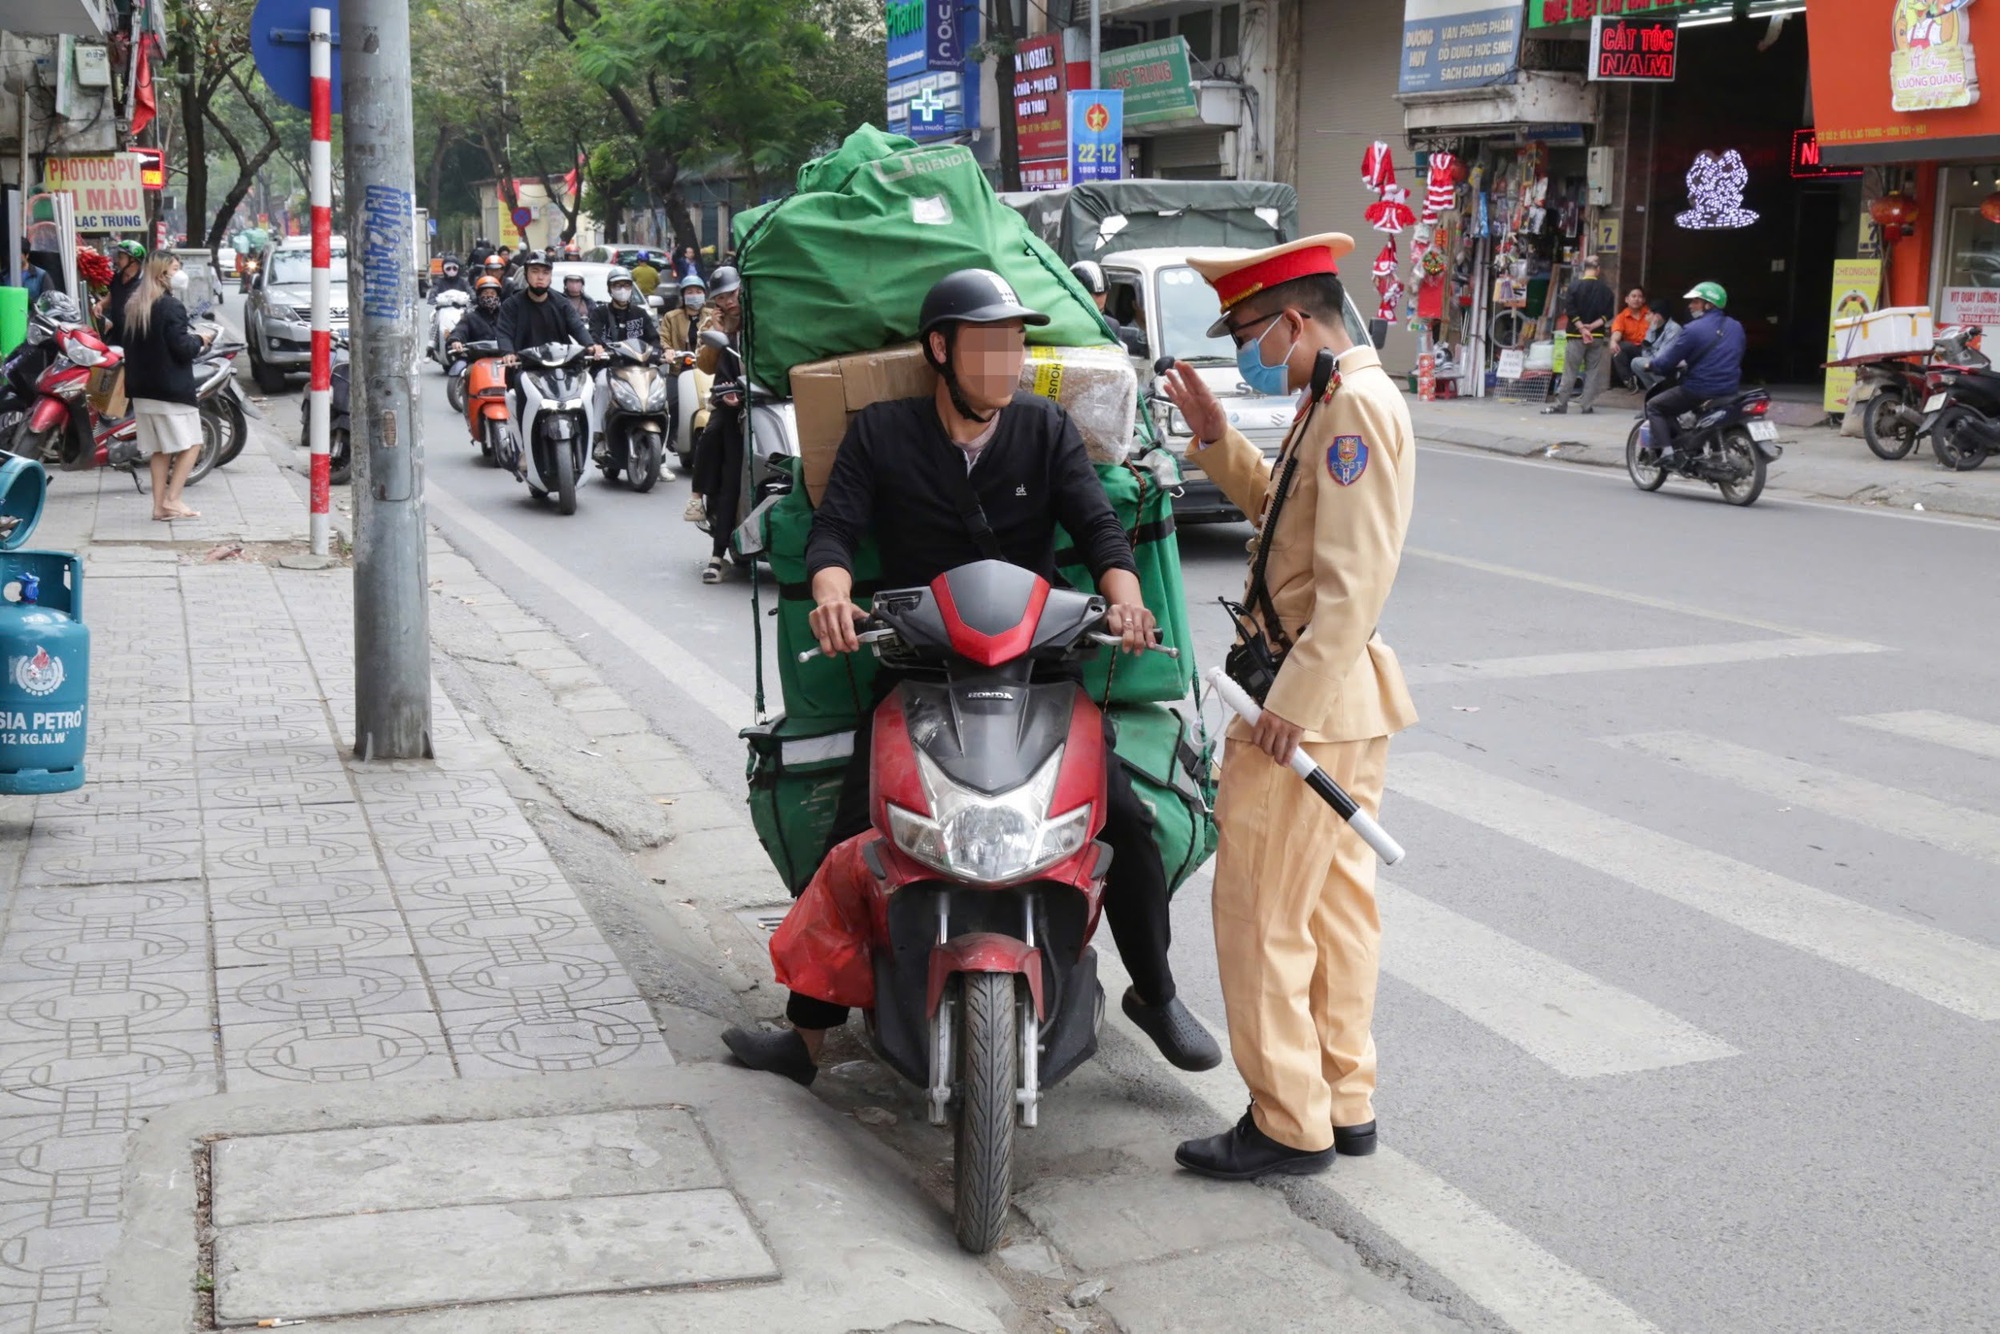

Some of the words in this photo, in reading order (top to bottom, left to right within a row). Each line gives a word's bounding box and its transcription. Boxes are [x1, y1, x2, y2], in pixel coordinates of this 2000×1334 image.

[1602, 21, 1636, 51] CẮT
[1641, 24, 1674, 51] TÓC
[1492, 40, 1513, 54] SINH
[1023, 46, 1054, 70] MOBILE
[1600, 54, 1673, 77] NAM
[1078, 143, 1117, 163] 22-12
[47, 157, 136, 182] PHOTOCOPY
[1100, 166, 1117, 174] 2025
[86, 183, 139, 212] MÀU
[75, 215, 98, 230] LẠC
[101, 215, 141, 228] TRUNG
[1047, 363, 1062, 402] HOUSE
[967, 691, 1014, 700] HONDA
[33, 710, 82, 730] PETRO
[1, 733, 16, 745] 12
